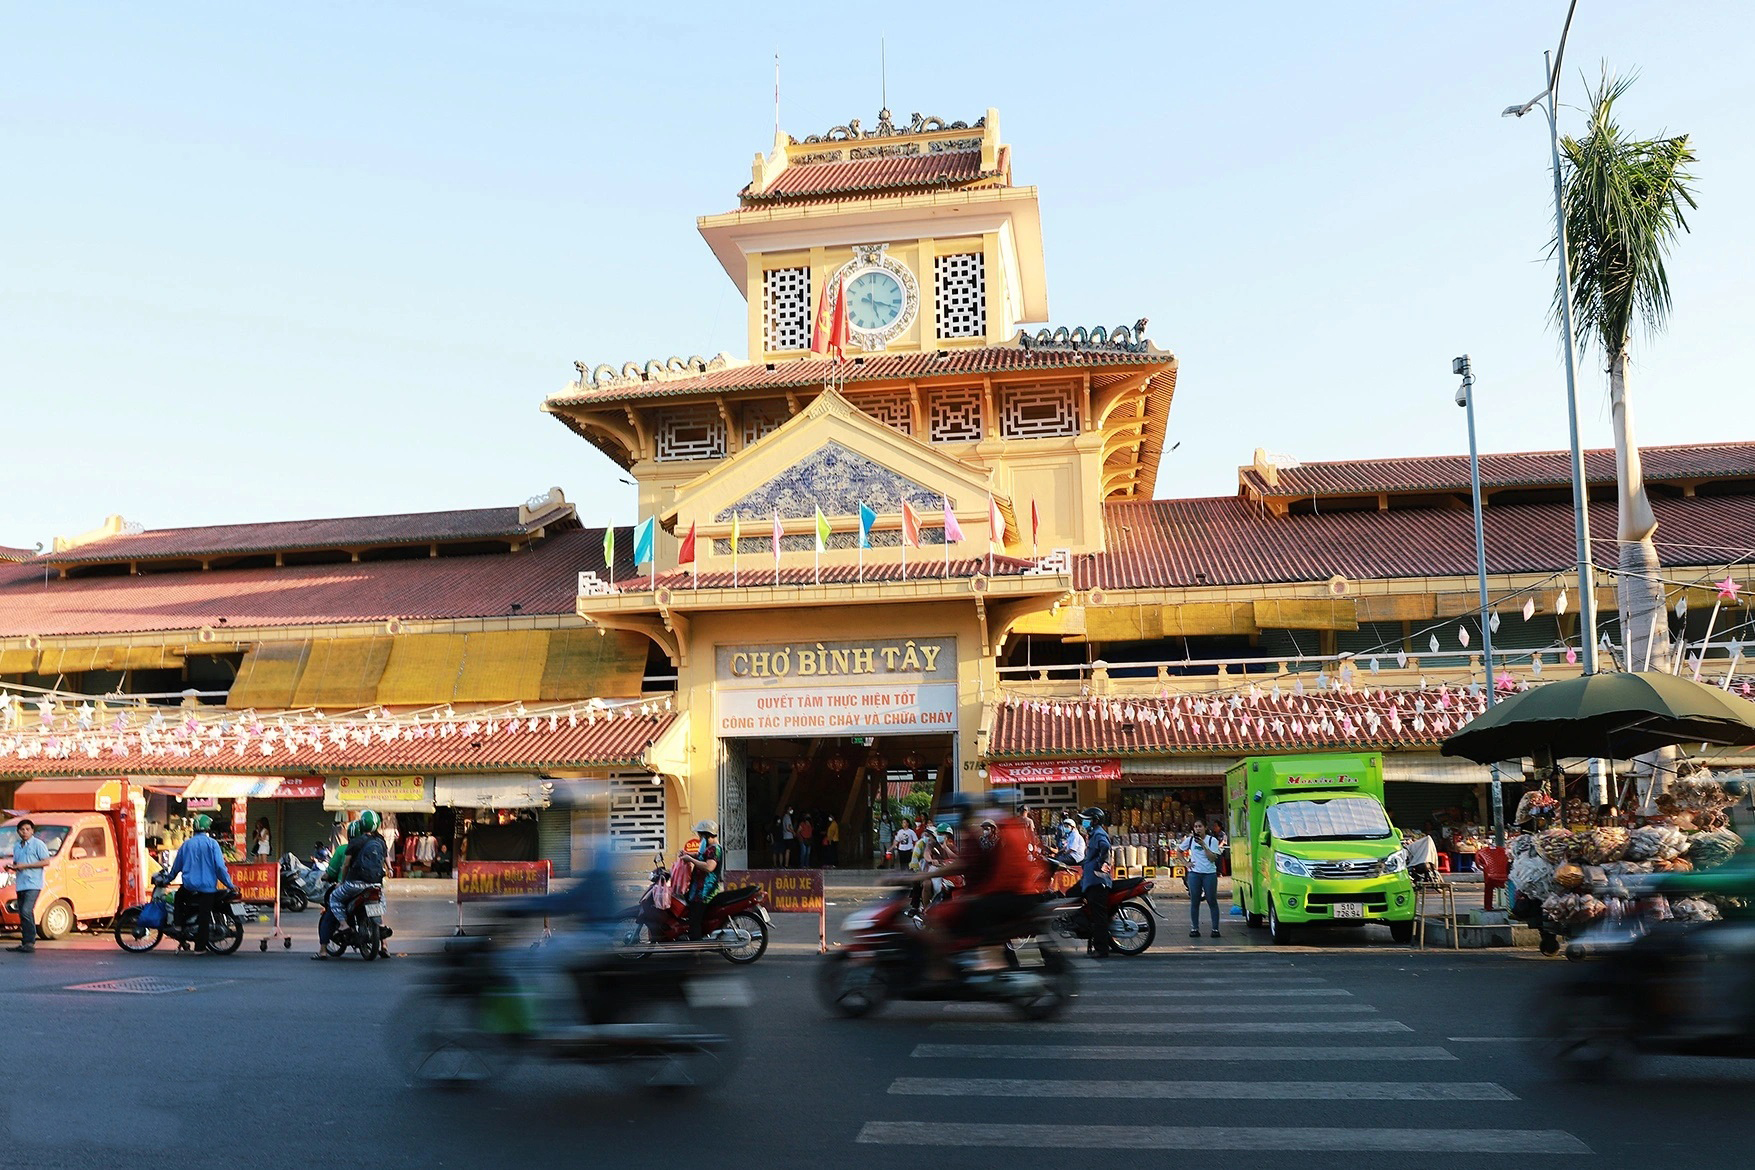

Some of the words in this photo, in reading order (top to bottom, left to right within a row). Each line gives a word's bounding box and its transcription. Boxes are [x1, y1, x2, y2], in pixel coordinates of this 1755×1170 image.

[730, 648, 790, 683] CHỢ
[797, 642, 876, 676] BÌNH
[880, 640, 941, 672] TÂY
[757, 693, 794, 710] QUYẾT
[799, 694, 823, 708] TÂM
[827, 694, 857, 709] THỰC
[862, 692, 890, 708] HIỆN
[894, 690, 915, 705] TỐT
[722, 714, 754, 729] CÔNG
[758, 713, 780, 728] TÁC
[784, 713, 825, 727] PHÒNG
[829, 712, 860, 726] CHÁY
[864, 712, 880, 725] VÀ
[884, 711, 916, 725] CHỮA
[921, 710, 953, 723] CHÁY
[1009, 766, 1054, 776] HỒNG
[1059, 764, 1102, 774] TRÚC
[358, 779, 377, 787] KIM
[257, 870, 268, 881] XE
[460, 866, 494, 893] CẤM
[526, 870, 537, 881] XE
[775, 876, 796, 892] ĐẬU
[800, 878, 811, 890] XE
[776, 897, 798, 908] MUA
